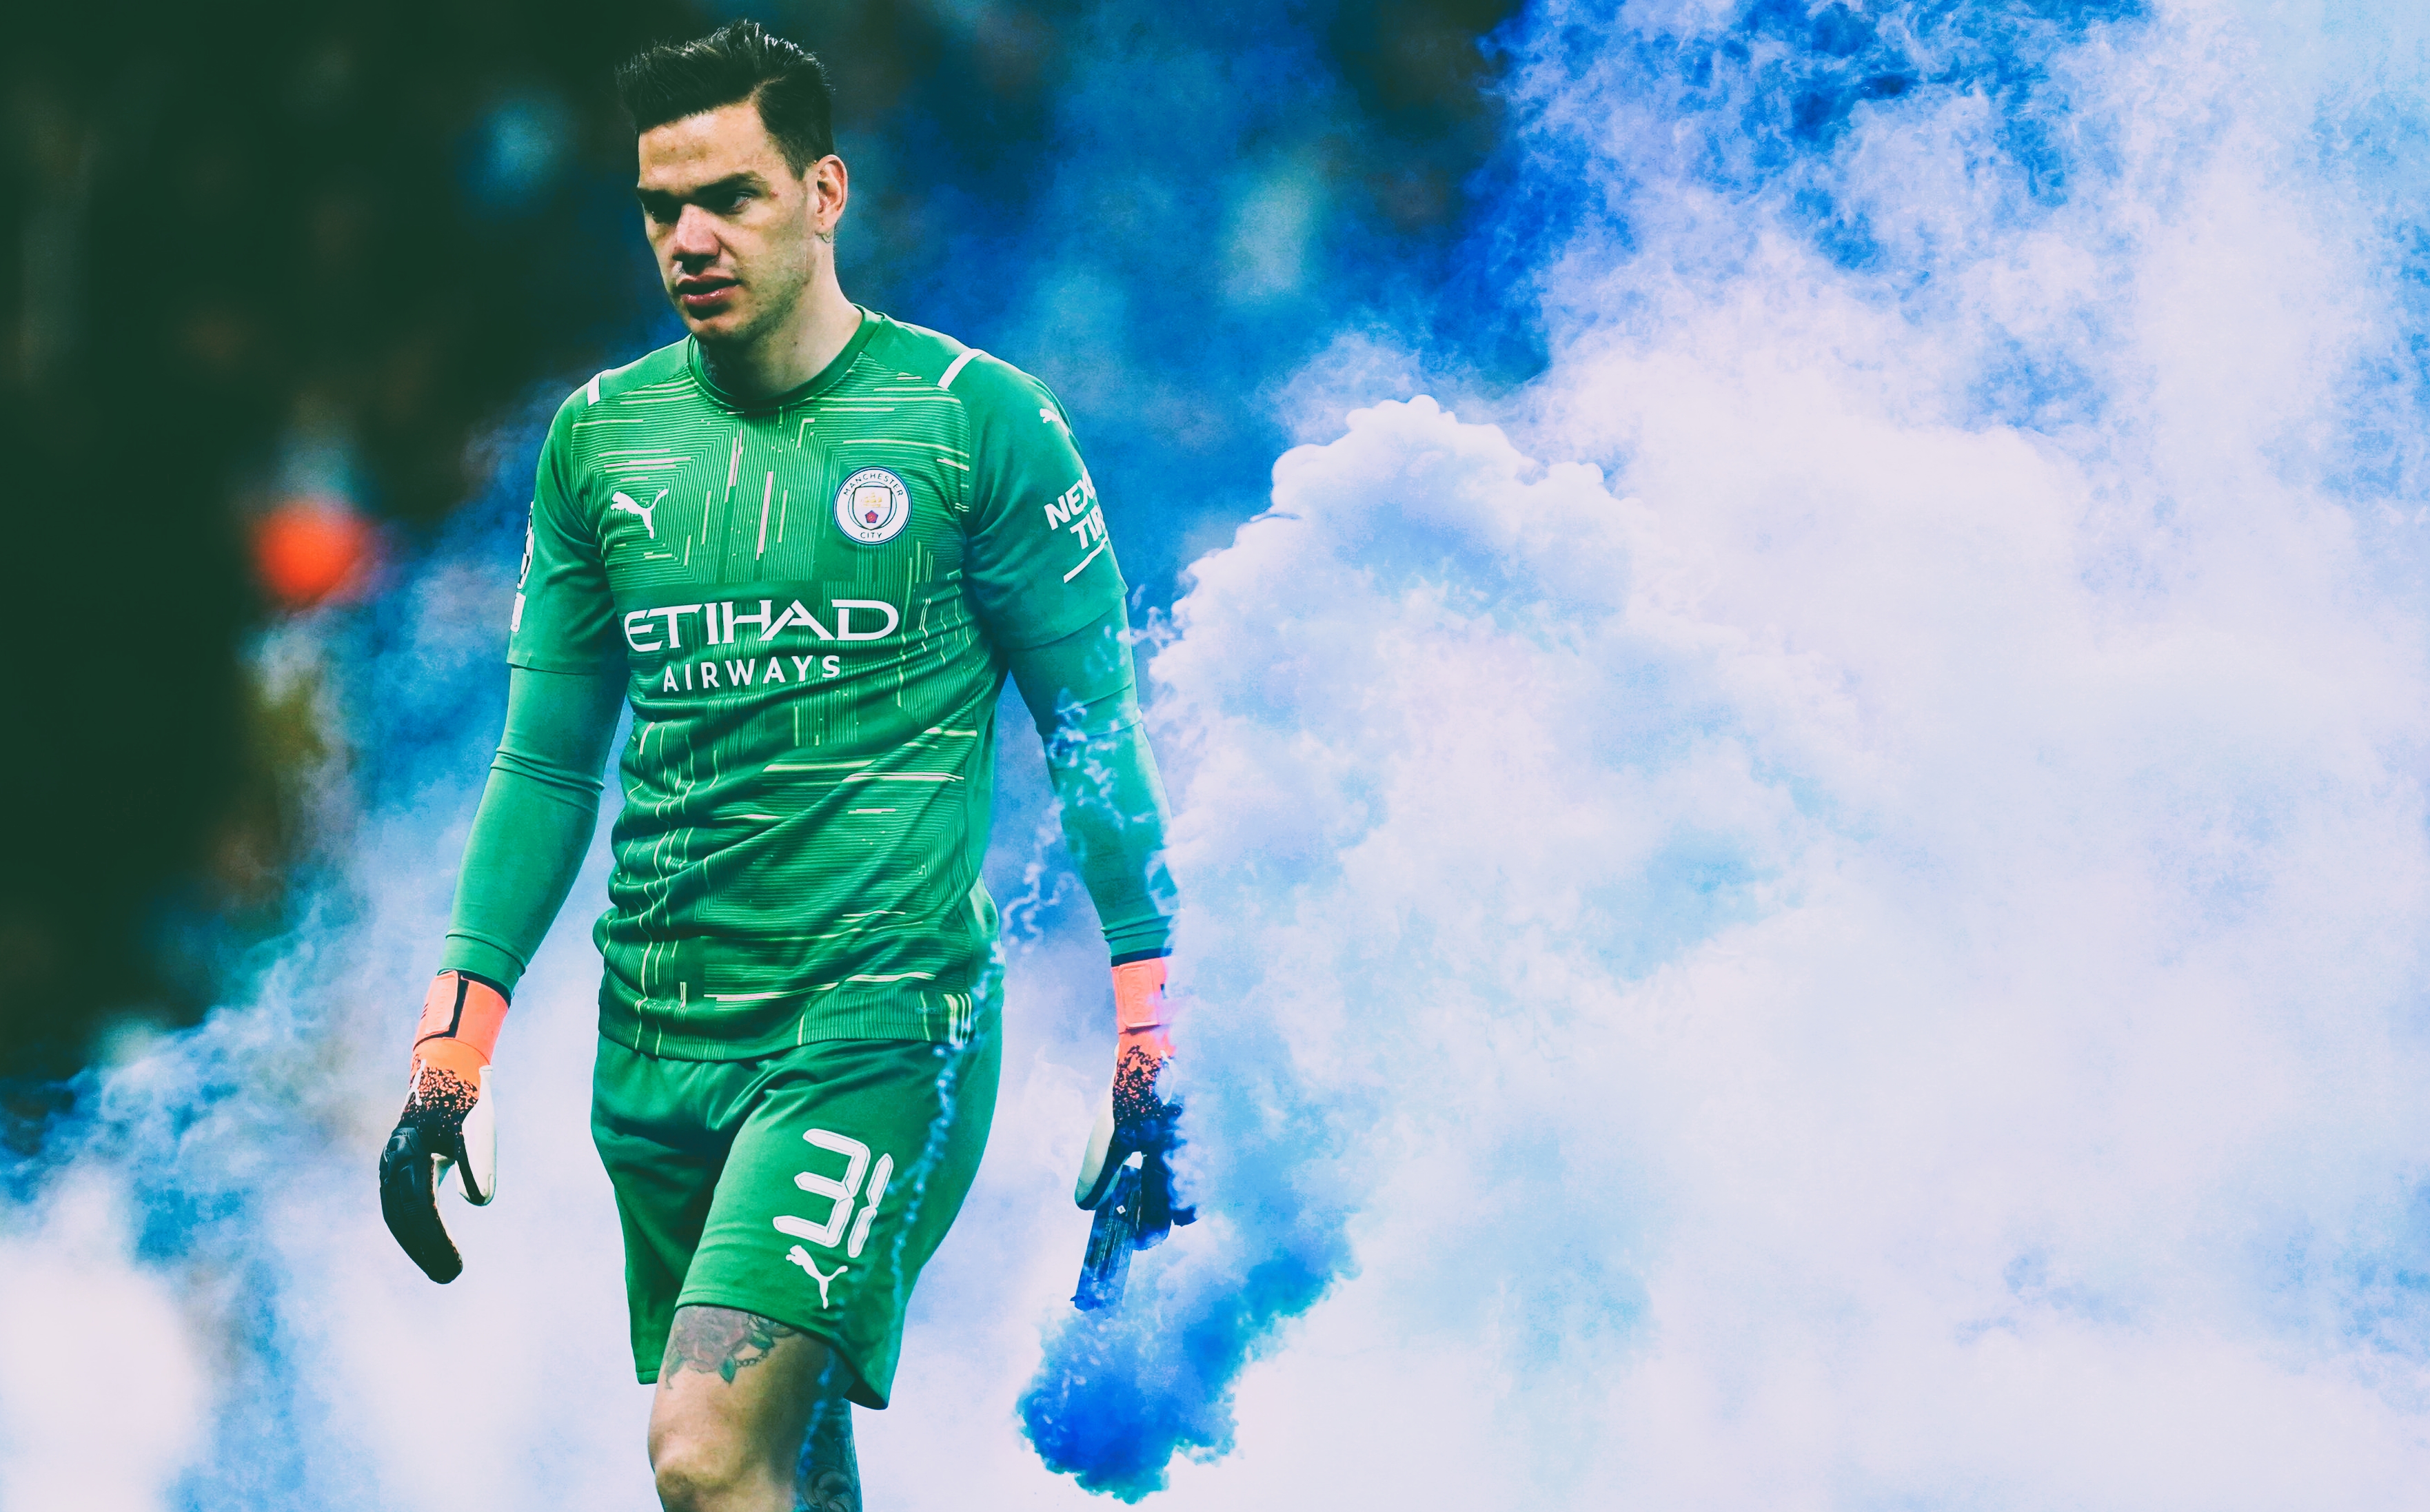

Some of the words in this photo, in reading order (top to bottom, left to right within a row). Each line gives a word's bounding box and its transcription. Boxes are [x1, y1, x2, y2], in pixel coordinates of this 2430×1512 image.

[843, 473, 904, 496] MANCHESTER
[1069, 504, 1106, 550] TIR
[624, 599, 899, 652] ETIHAD
[663, 655, 840, 693] AIRWAYS
[773, 1128, 893, 1258] 31
